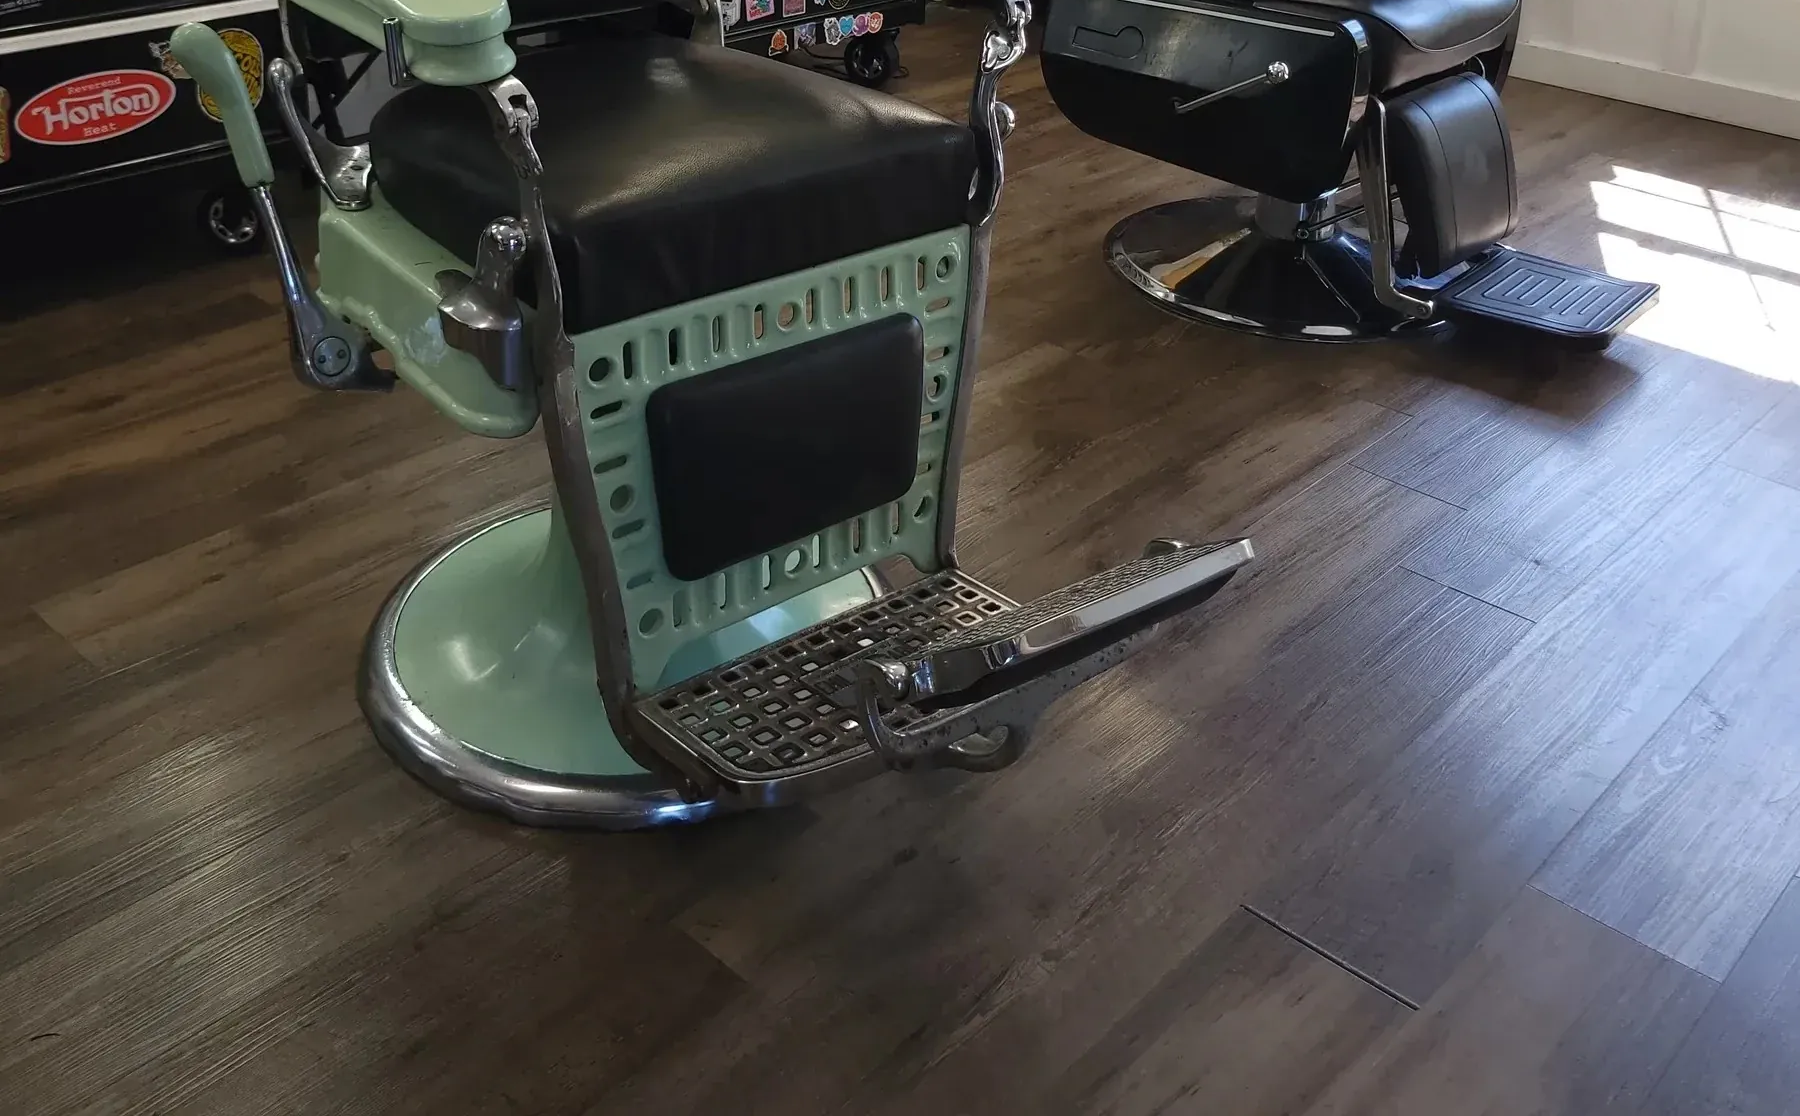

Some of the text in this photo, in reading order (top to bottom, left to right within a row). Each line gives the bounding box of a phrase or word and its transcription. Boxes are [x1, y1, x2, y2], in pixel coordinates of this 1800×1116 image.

[67, 76, 122, 96] Reverend
[31, 84, 161, 134] Horton
[82, 122, 119, 138] Heat
